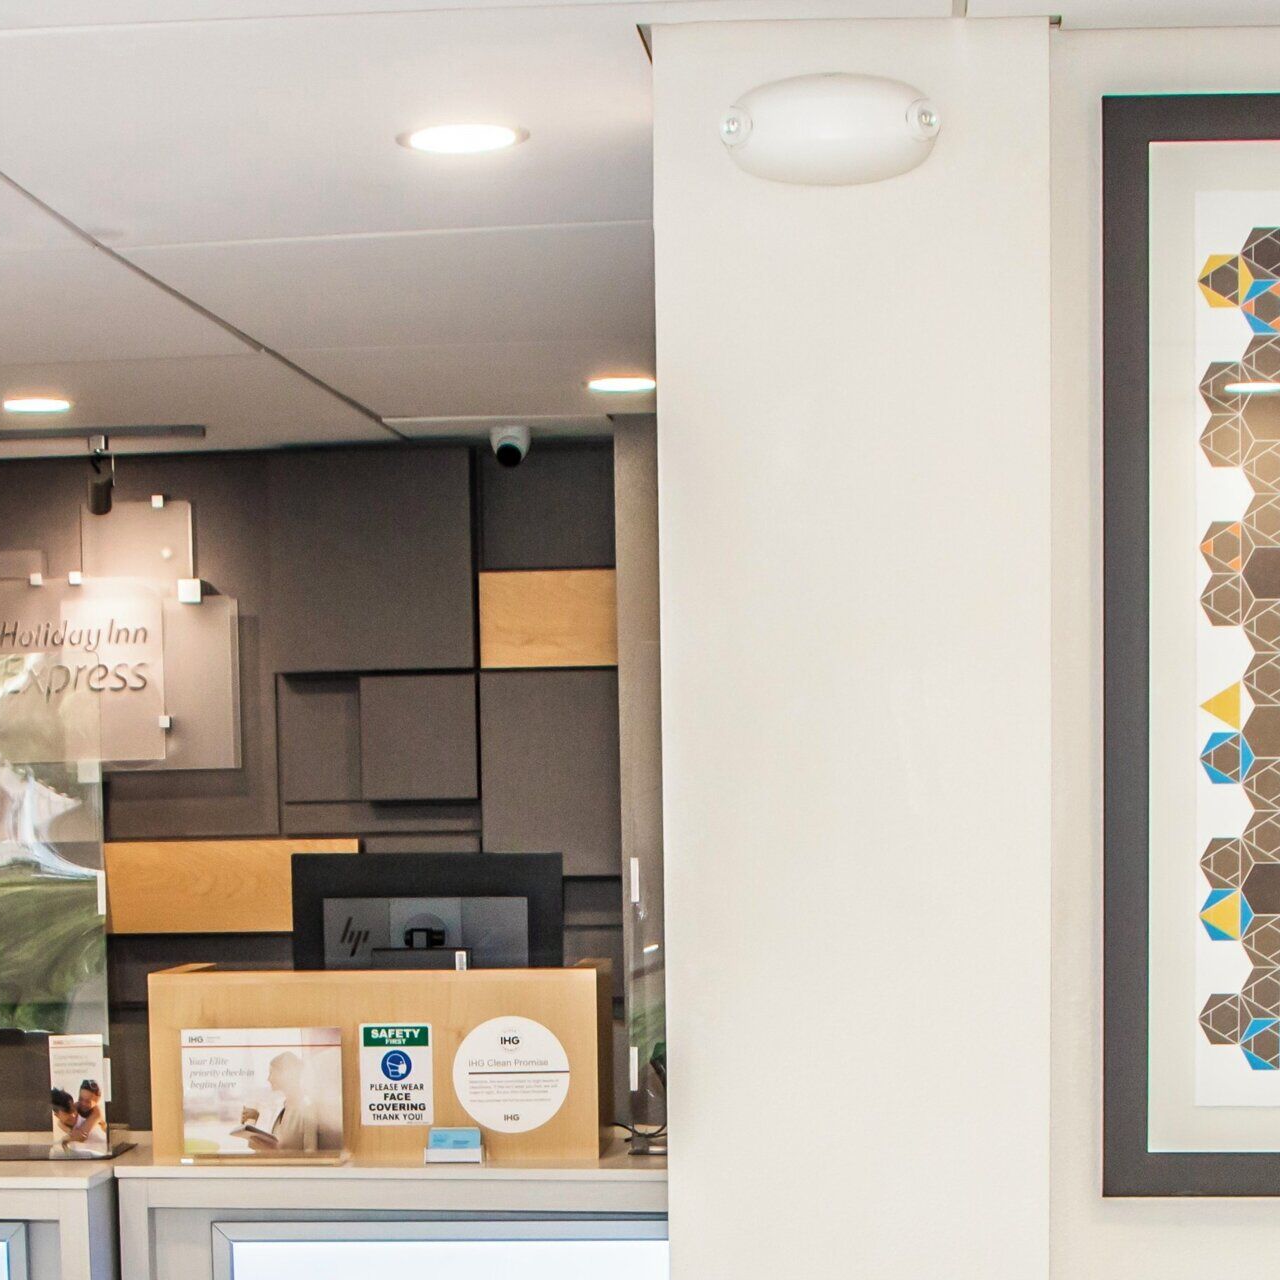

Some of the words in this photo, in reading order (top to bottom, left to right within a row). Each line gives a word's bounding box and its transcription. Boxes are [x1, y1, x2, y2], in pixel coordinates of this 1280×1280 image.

[0, 619, 101, 652] Holiday
[107, 618, 148, 645] Inn
[371, 1028, 420, 1039] SAFETY
[188, 1036, 204, 1044] IHG
[500, 1036, 520, 1045] IHG
[188, 1056, 207, 1066] Your
[209, 1056, 229, 1066] Elite
[468, 1059, 485, 1067] IHG
[487, 1058, 512, 1067] Clean
[514, 1058, 549, 1067] Promise
[189, 1068, 224, 1079] priority
[190, 1080, 218, 1090] begins
[218, 1080, 237, 1088] here
[369, 1083, 398, 1091] PLEASE
[401, 1083, 425, 1091] WEAR
[383, 1092, 411, 1101] FACE
[368, 1103, 426, 1112] COVERING
[372, 1113, 400, 1121] THANK
[403, 1113, 424, 1121] YOU!
[503, 1113, 520, 1122] IHG
